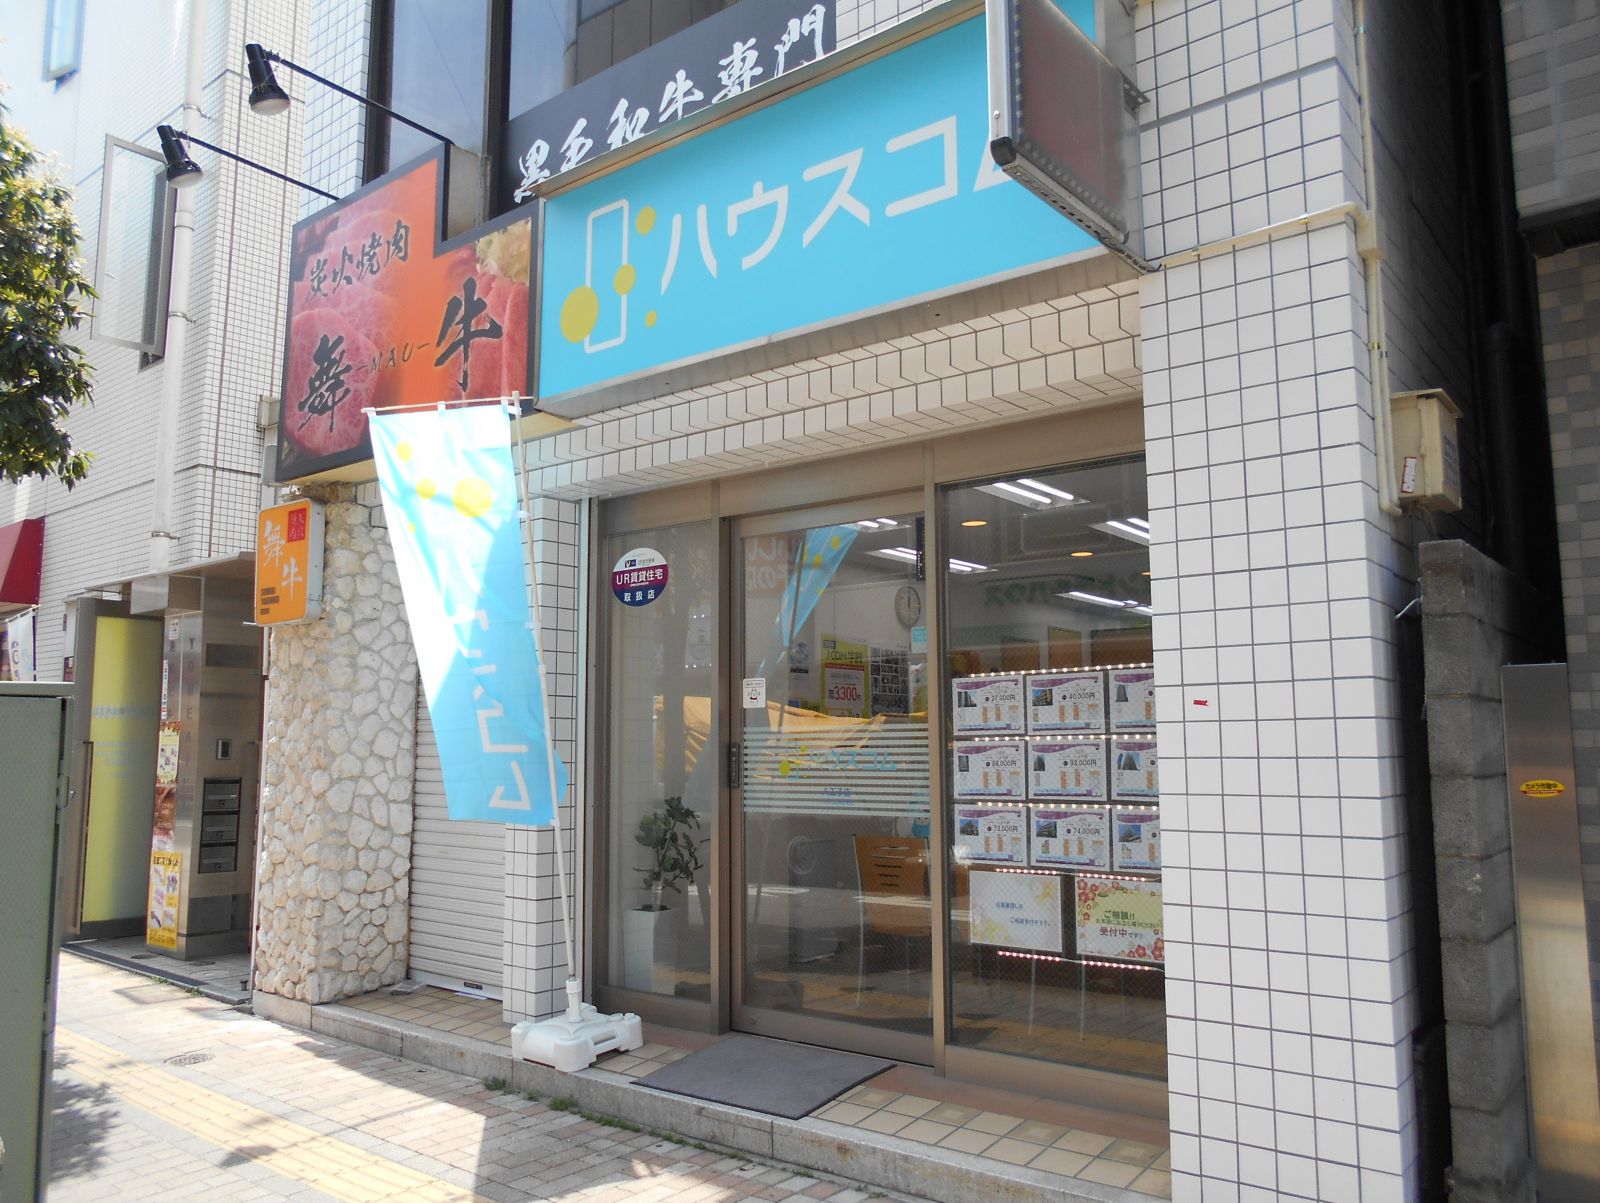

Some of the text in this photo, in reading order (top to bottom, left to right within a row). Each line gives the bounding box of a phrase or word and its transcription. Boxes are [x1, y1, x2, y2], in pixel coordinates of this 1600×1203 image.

[306, 219, 410, 303] 炭火焼肉
[616, 568, 664, 585] UR賃貸住宅
